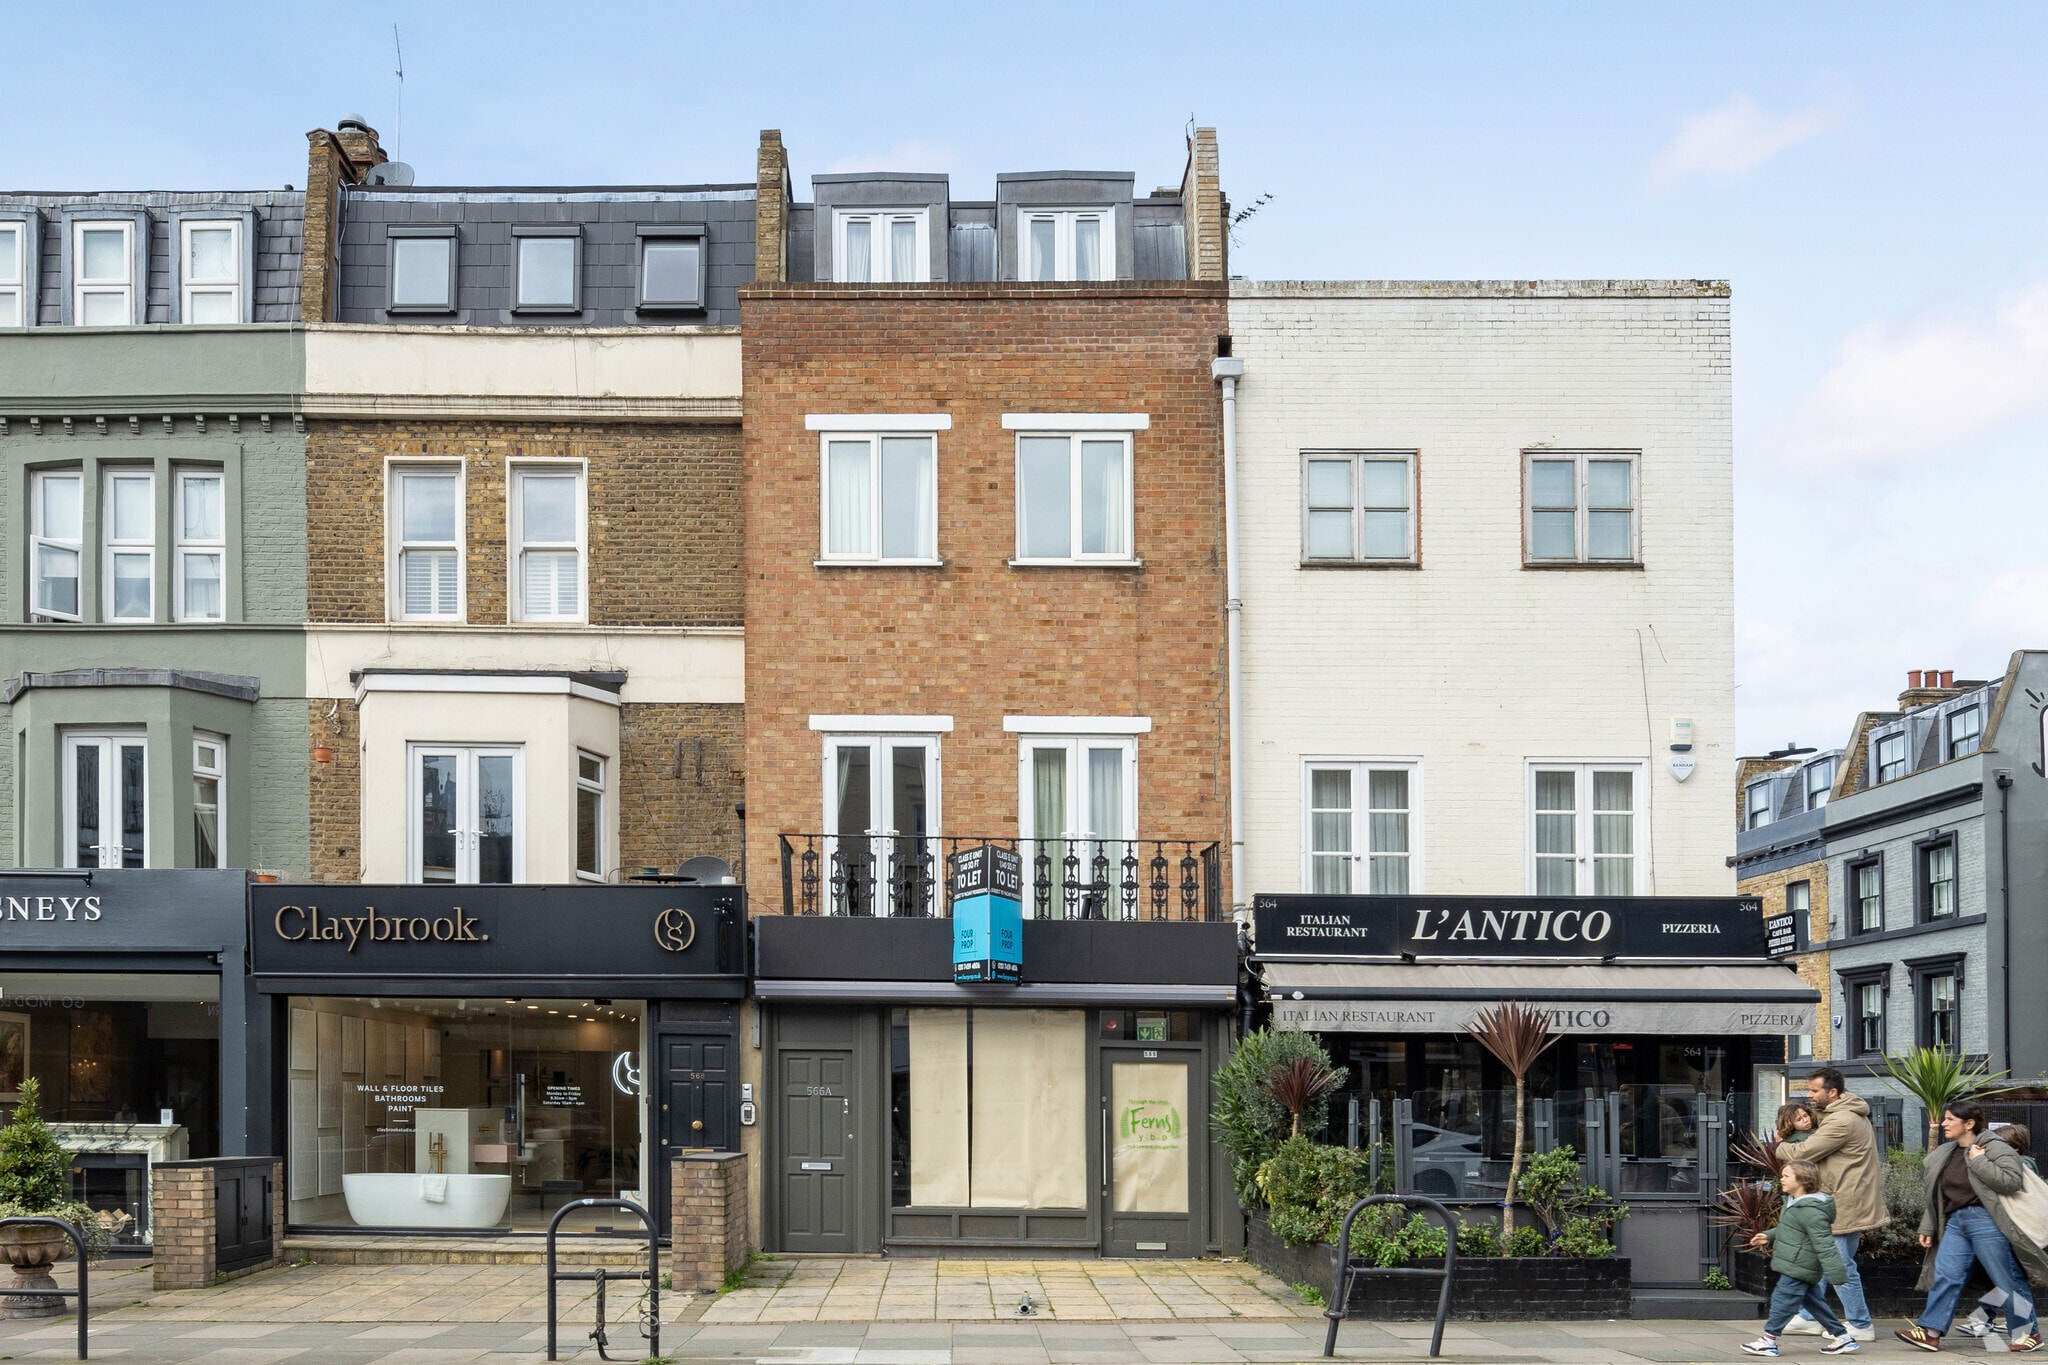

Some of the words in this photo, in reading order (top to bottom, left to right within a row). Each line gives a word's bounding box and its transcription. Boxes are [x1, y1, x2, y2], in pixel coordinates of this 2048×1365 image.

[957, 873, 966, 889] TO
[967, 869, 982, 887] LET
[996, 870, 1006, 886] TO
[1007, 872, 1019, 889] LET
[0, 896, 101, 921] NEYS
[1259, 898, 1277, 908] 564
[1739, 902, 1758, 911] 564
[1300, 914, 1351, 925] ITALIAN
[275, 906, 490, 951] Claybrook.
[1411, 909, 1612, 942] L'ANTICO
[1662, 923, 1721, 934] PIZZERIA
[1286, 926, 1368, 937] RESTAURANT
[1283, 1010, 1338, 1022] ITALIAN
[1342, 1011, 1436, 1023] RESTAURANT
[1741, 1014, 1804, 1026] PIZZERIA
[1684, 1047, 1701, 1057] 564
[356, 1084, 380, 1092] WALL
[382, 1084, 389, 1092] &
[420, 1085, 445, 1093] TILES
[806, 1086, 832, 1096] 566A
[374, 1095, 427, 1103] BATHROOMS
[1130, 1106, 1171, 1134] Ferns
